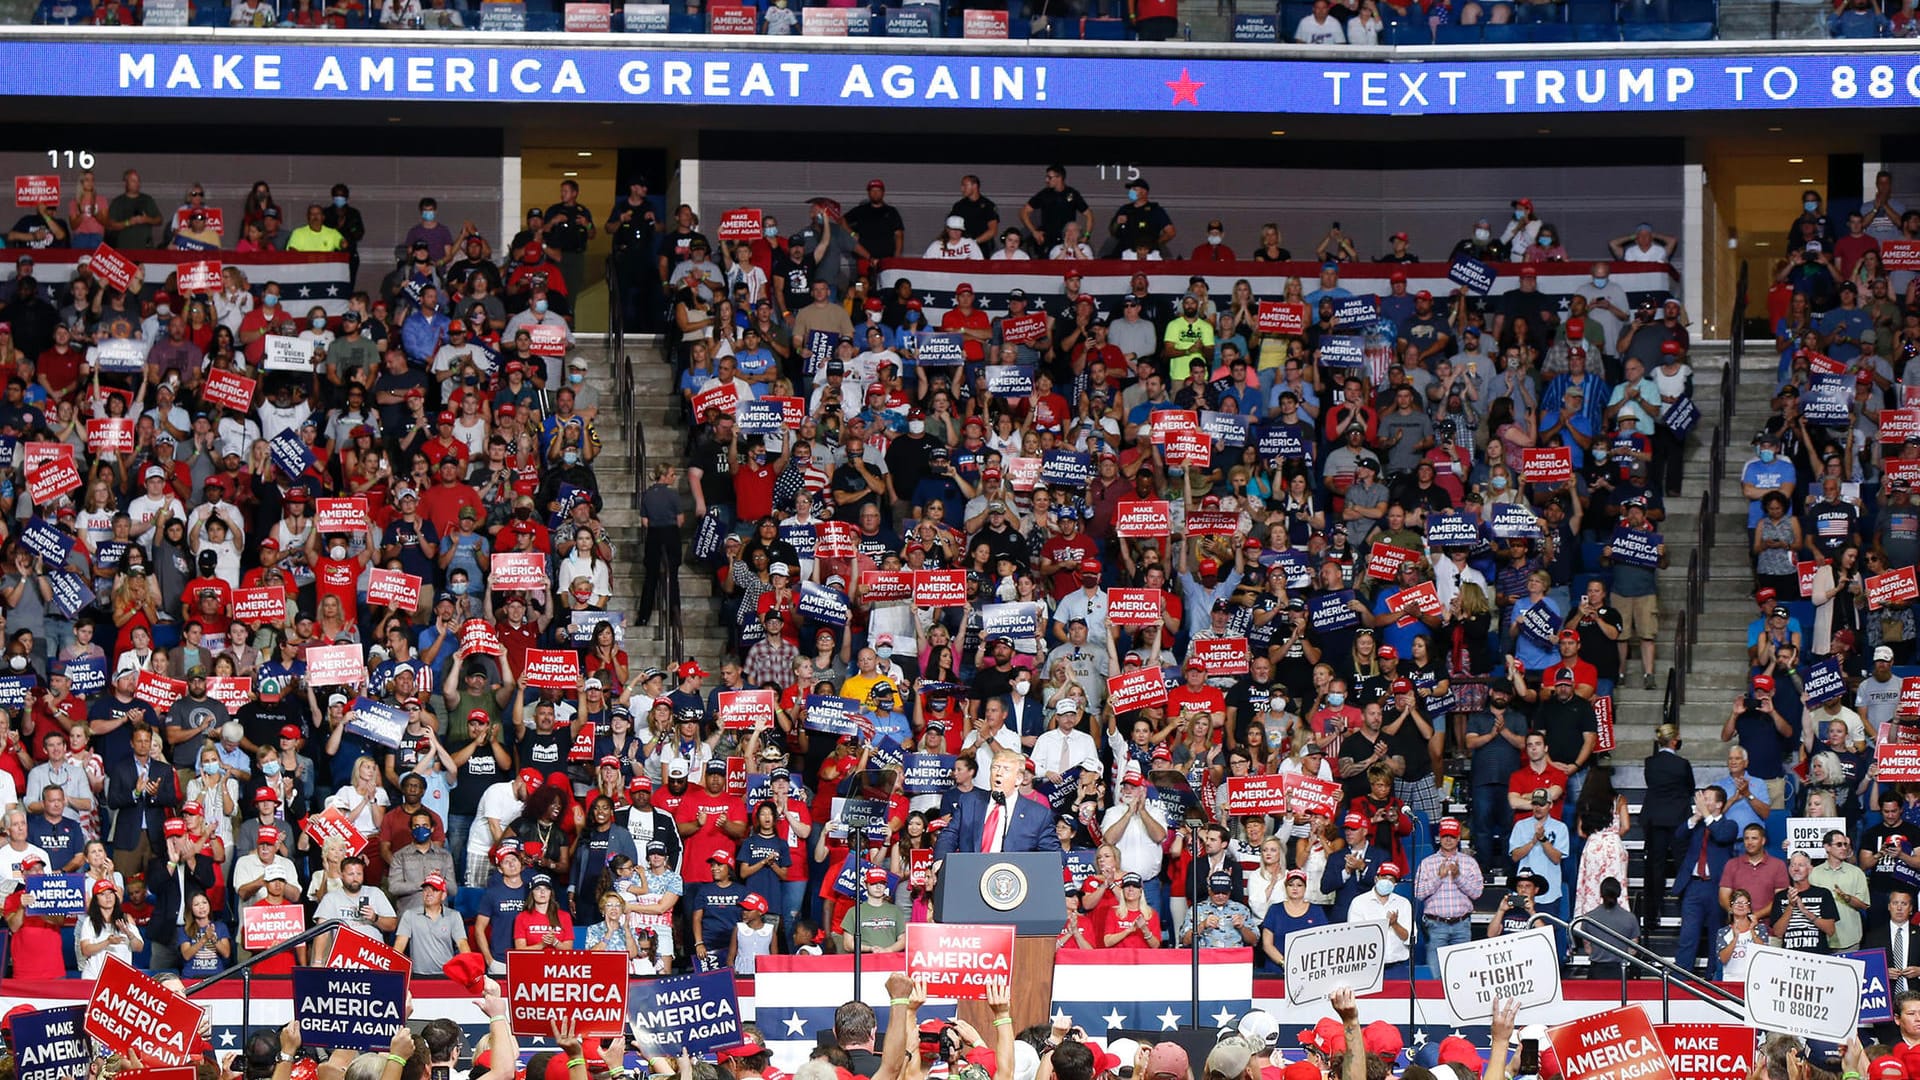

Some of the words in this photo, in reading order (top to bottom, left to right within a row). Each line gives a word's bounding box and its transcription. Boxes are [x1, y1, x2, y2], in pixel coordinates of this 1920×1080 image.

[120, 54, 280, 89] MAKE
[314, 56, 586, 94] AMERICA
[619, 60, 808, 96] GREAT
[840, 64, 1046, 101] AGAIN!
[1324, 72, 1466, 106] TEXT
[1496, 68, 1694, 104] TRUMP
[1725, 66, 1798, 100] TO
[48, 150, 94, 169] 116
[918, 345, 962, 353] AMERICA
[222, 377, 240, 387] MAKE
[209, 381, 248, 398] AMERICA
[207, 389, 226, 399] GREAT
[227, 396, 248, 405] AGAIN
[738, 413, 781, 422] AMERICA
[1525, 460, 1569, 468] AMERICA
[1524, 470, 1546, 478] GREAT
[1121, 514, 1166, 522] AMERICA
[1817, 512, 1848, 520] TRUMP
[1430, 524, 1476, 533] AMERICA
[917, 583, 964, 591] AMERICA
[816, 591, 837, 600] MAKE
[236, 600, 282, 610] AMERICA
[802, 594, 848, 612] AMERICA
[1110, 602, 1157, 610] AMERICA
[800, 604, 823, 614] GREAT
[824, 610, 846, 620] AGAIN
[998, 609, 1021, 617] MAKE
[986, 615, 1034, 626] AMERICA
[987, 626, 1010, 634] GREAT
[528, 662, 576, 673] AMERICA
[1811, 667, 1827, 678] MAKE
[528, 672, 552, 680] GREAT
[1124, 675, 1144, 685] MAKE
[1805, 672, 1840, 690] AMERICA
[1140, 690, 1164, 700] AGAIN
[1807, 688, 1824, 700] REAT
[1825, 681, 1843, 692] AGAIN
[1870, 692, 1898, 700] TRUMP
[1231, 788, 1282, 800] AMERICA
[1229, 801, 1256, 809] GREAT
[1794, 828, 1819, 840] COPS
[1795, 841, 1811, 849] FOR
[43, 880, 66, 888] MAKE
[57, 900, 83, 908] AGAIN
[939, 937, 982, 948] MAKE
[911, 950, 1008, 970] AMERICA
[1300, 942, 1377, 972] VETERANS
[1486, 950, 1512, 966] TEXT
[544, 965, 591, 978] MAKE
[1308, 970, 1326, 981] FOR
[1330, 962, 1368, 978] TRUMP
[1790, 966, 1816, 982] TEXT
[912, 971, 958, 984] GREAT
[962, 972, 1008, 986] AGAIN
[328, 981, 371, 994] MAKE
[514, 983, 622, 1002] AMERICA
[1476, 990, 1490, 1003] TO
[1495, 980, 1534, 1000] 88022
[127, 983, 167, 1016] MAKE
[660, 987, 701, 1004] MAKE
[301, 997, 400, 1018] AMERICA
[1772, 999, 1786, 1014] TO
[1790, 1003, 1828, 1020] 88022
[96, 987, 184, 1051] AMERICA
[515, 1008, 567, 1020] GREAT
[572, 1008, 621, 1021] AGAIN
[635, 999, 734, 1030] AMERICA
[46, 1022, 74, 1038] MAKE
[91, 1008, 132, 1041] GREAT
[301, 1017, 349, 1035] GREAT
[353, 1022, 402, 1036] AGAIN
[689, 1020, 736, 1040] AGAIN
[1790, 1026, 1808, 1034] 2020
[1581, 1024, 1622, 1047] MAKE
[1674, 1038, 1718, 1050] MAKE
[22, 1038, 88, 1066] AMERICA
[1565, 1036, 1657, 1080] AMERICA
[1621, 1057, 1666, 1080] AGAIN
[1667, 1055, 1747, 1073] MERICA
